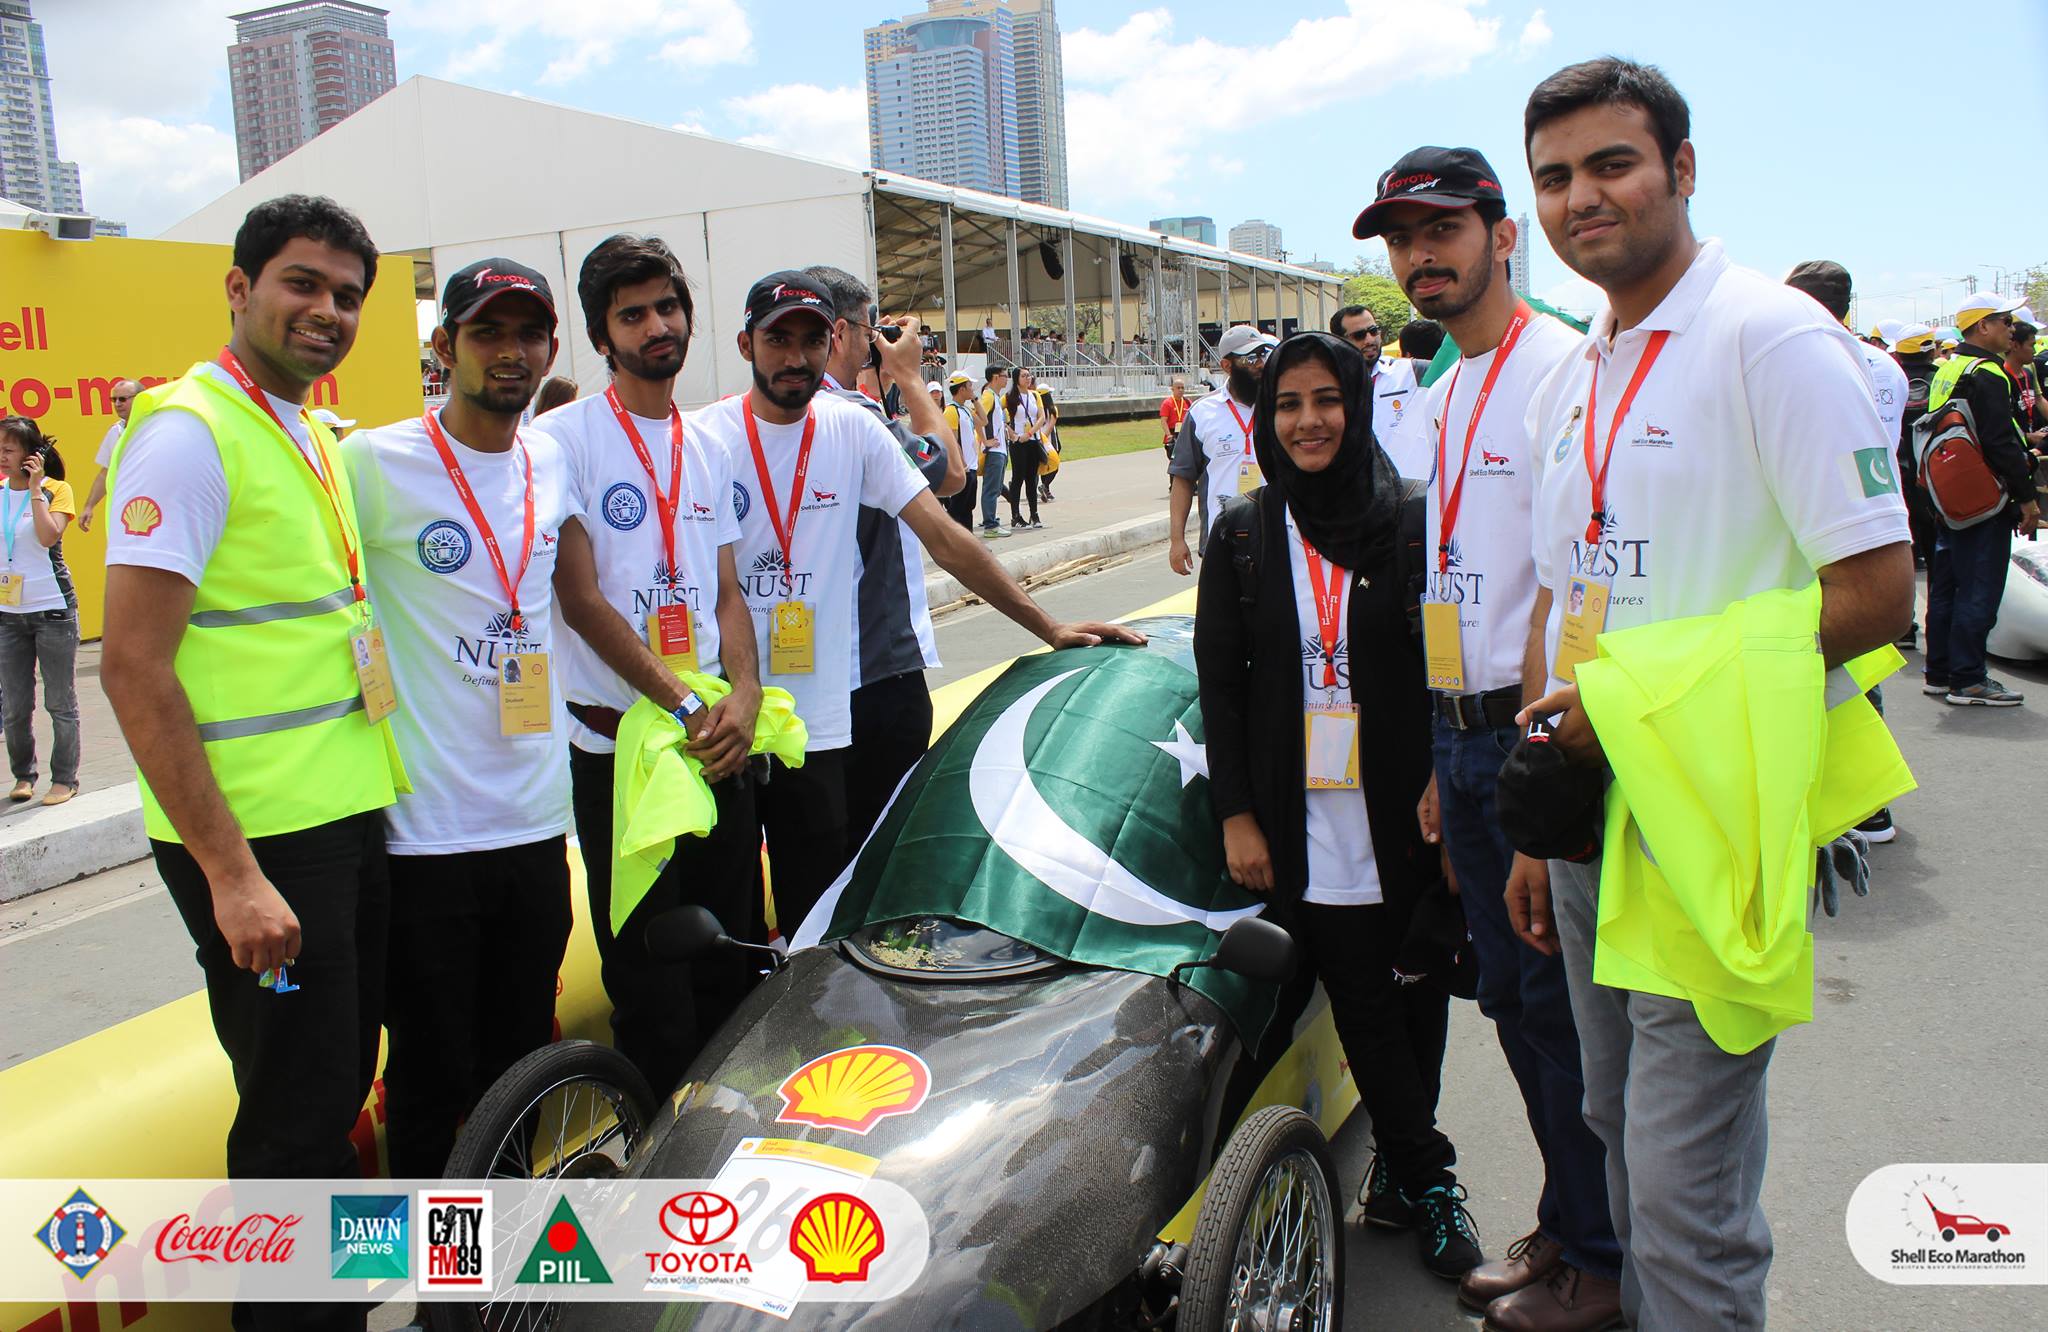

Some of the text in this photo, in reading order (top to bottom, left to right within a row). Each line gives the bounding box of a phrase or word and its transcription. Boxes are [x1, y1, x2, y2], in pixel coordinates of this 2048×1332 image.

[1389, 173, 1435, 189] TOYOTA
[486, 274, 530, 284] TOYOTA
[783, 289, 817, 298] TOYOTA
[1428, 572, 1483, 604] NUST
[1305, 662, 1350, 690] US
